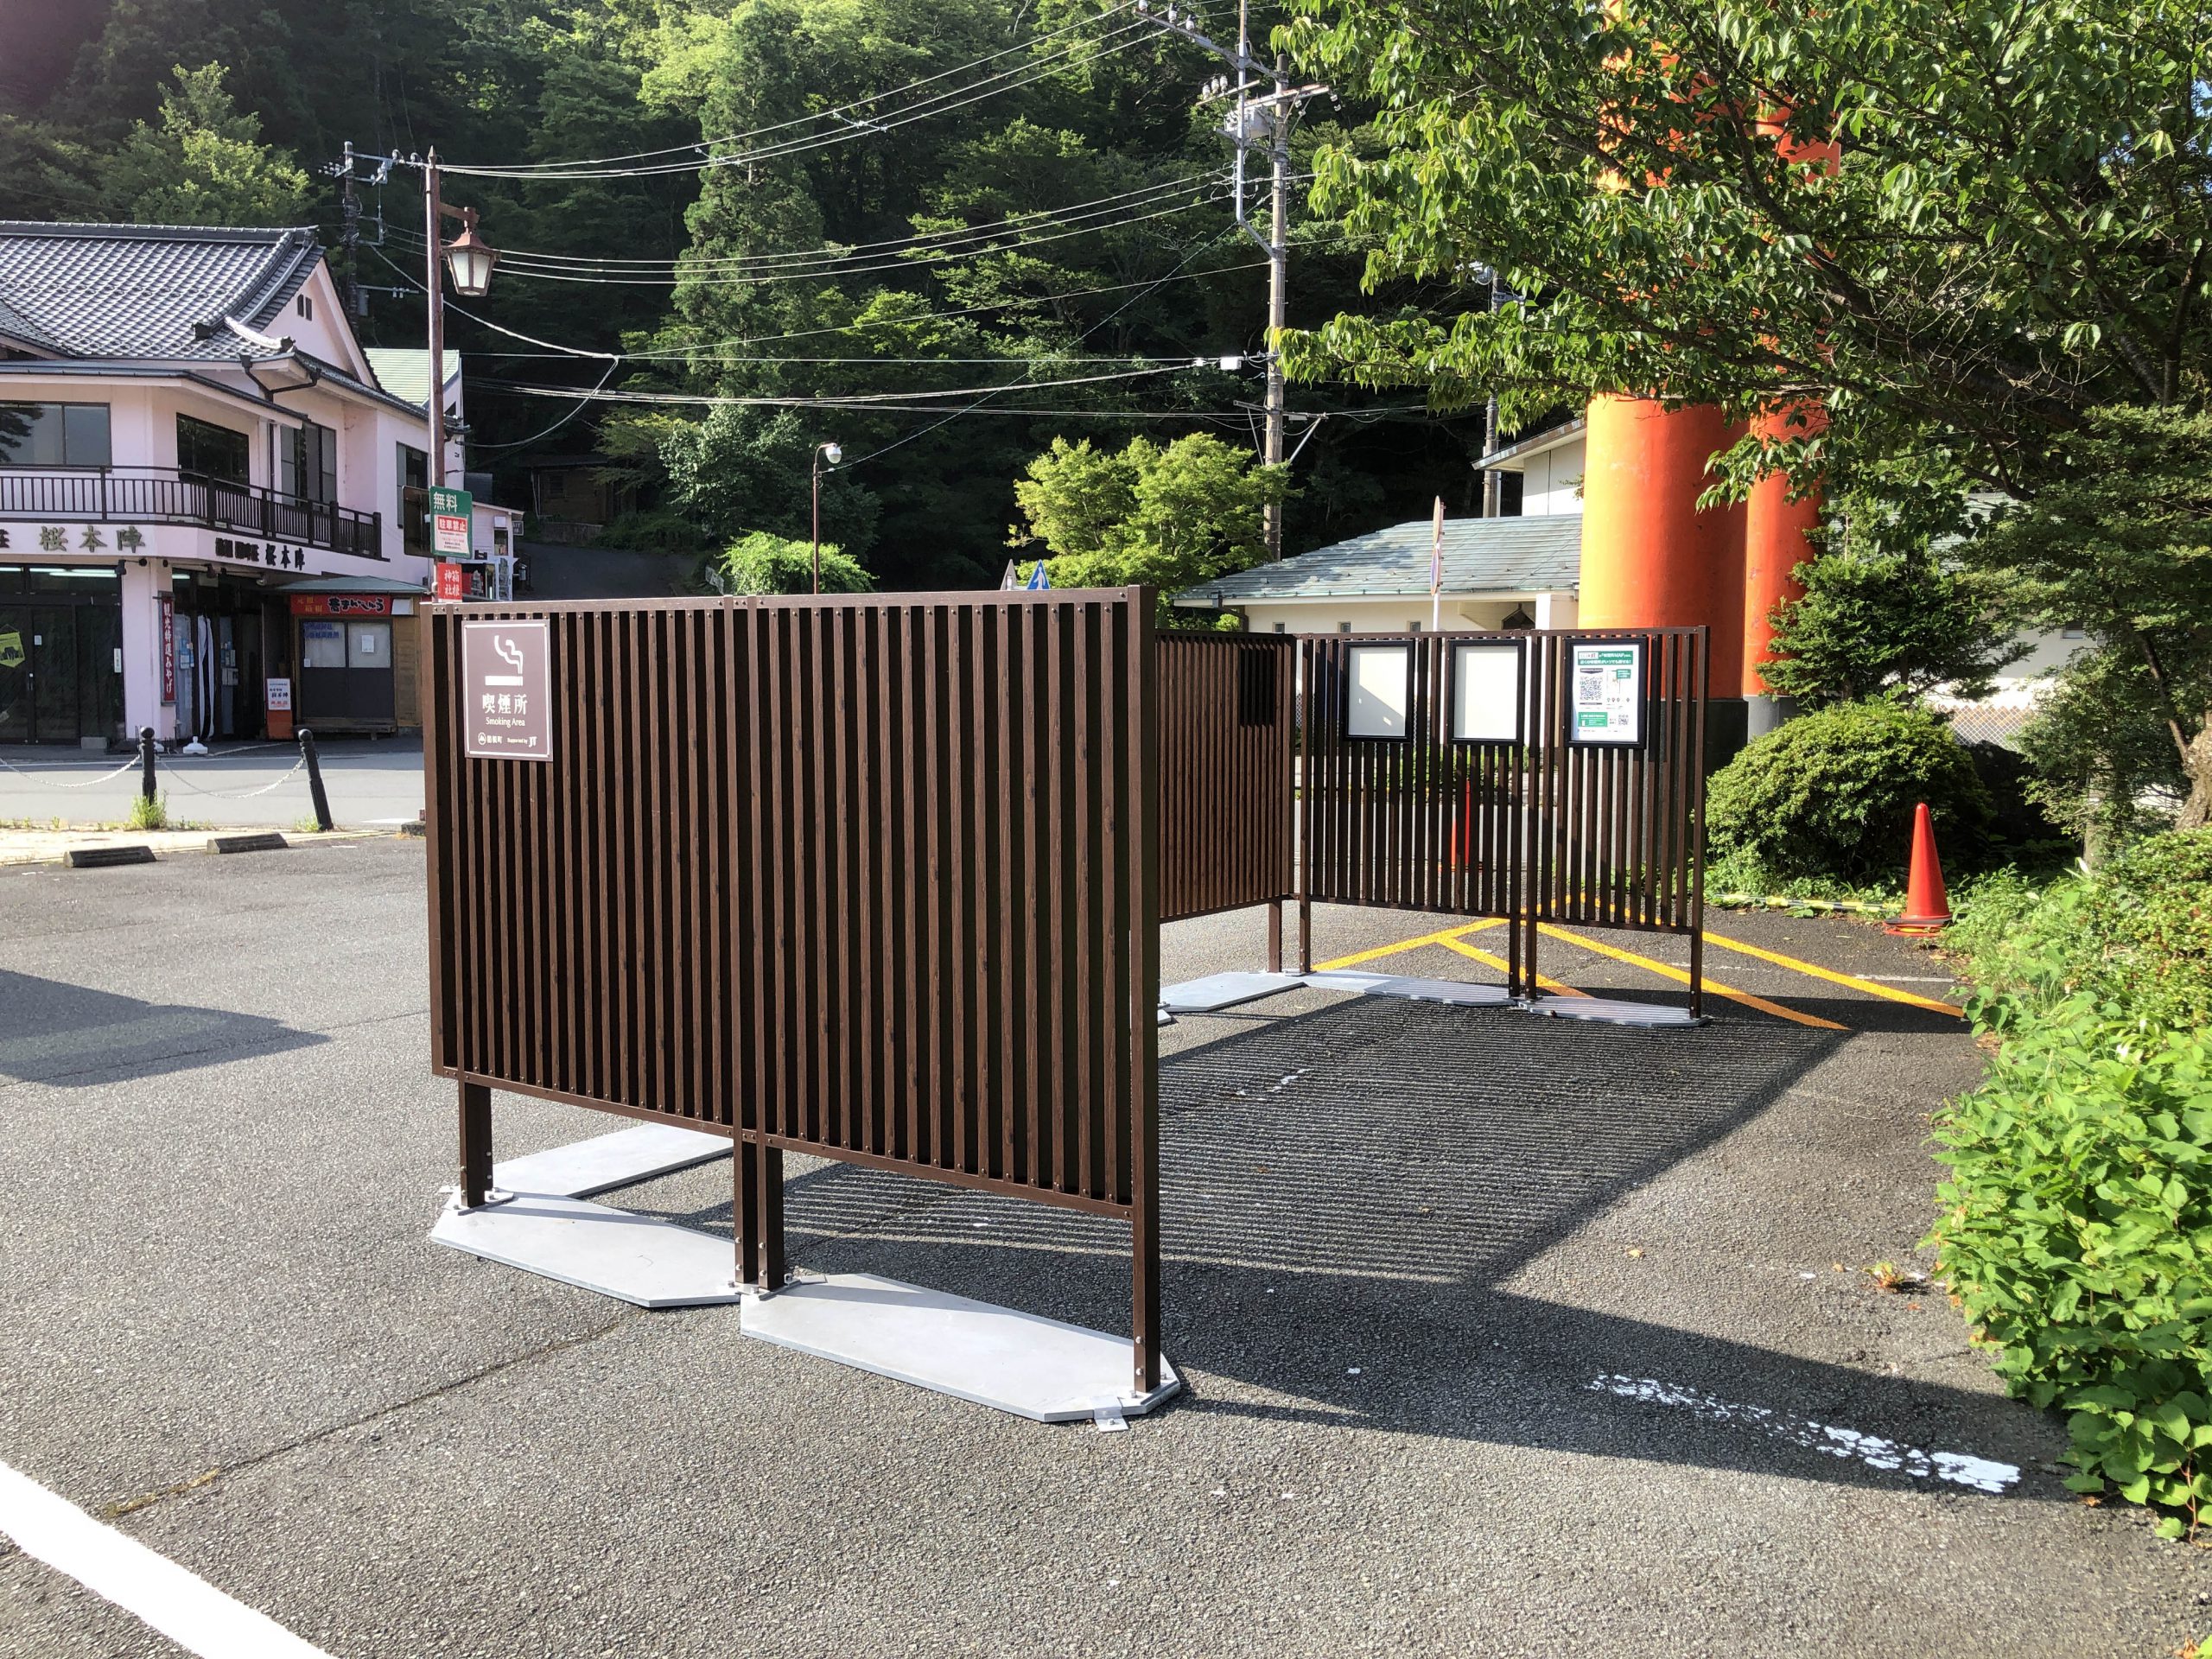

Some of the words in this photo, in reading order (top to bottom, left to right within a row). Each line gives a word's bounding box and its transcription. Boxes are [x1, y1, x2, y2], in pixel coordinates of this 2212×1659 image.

[433, 491, 457, 512] 無料
[439, 518, 467, 532] 駐車禁止
[39, 525, 145, 553] 桜本陣
[444, 569, 453, 597] 神社
[451, 569, 461, 597] 箱根
[482, 693, 527, 715] 喫煙所
[486, 716, 511, 728] Smoking
[512, 718, 525, 727] Area
[528, 736, 537, 747] JT
